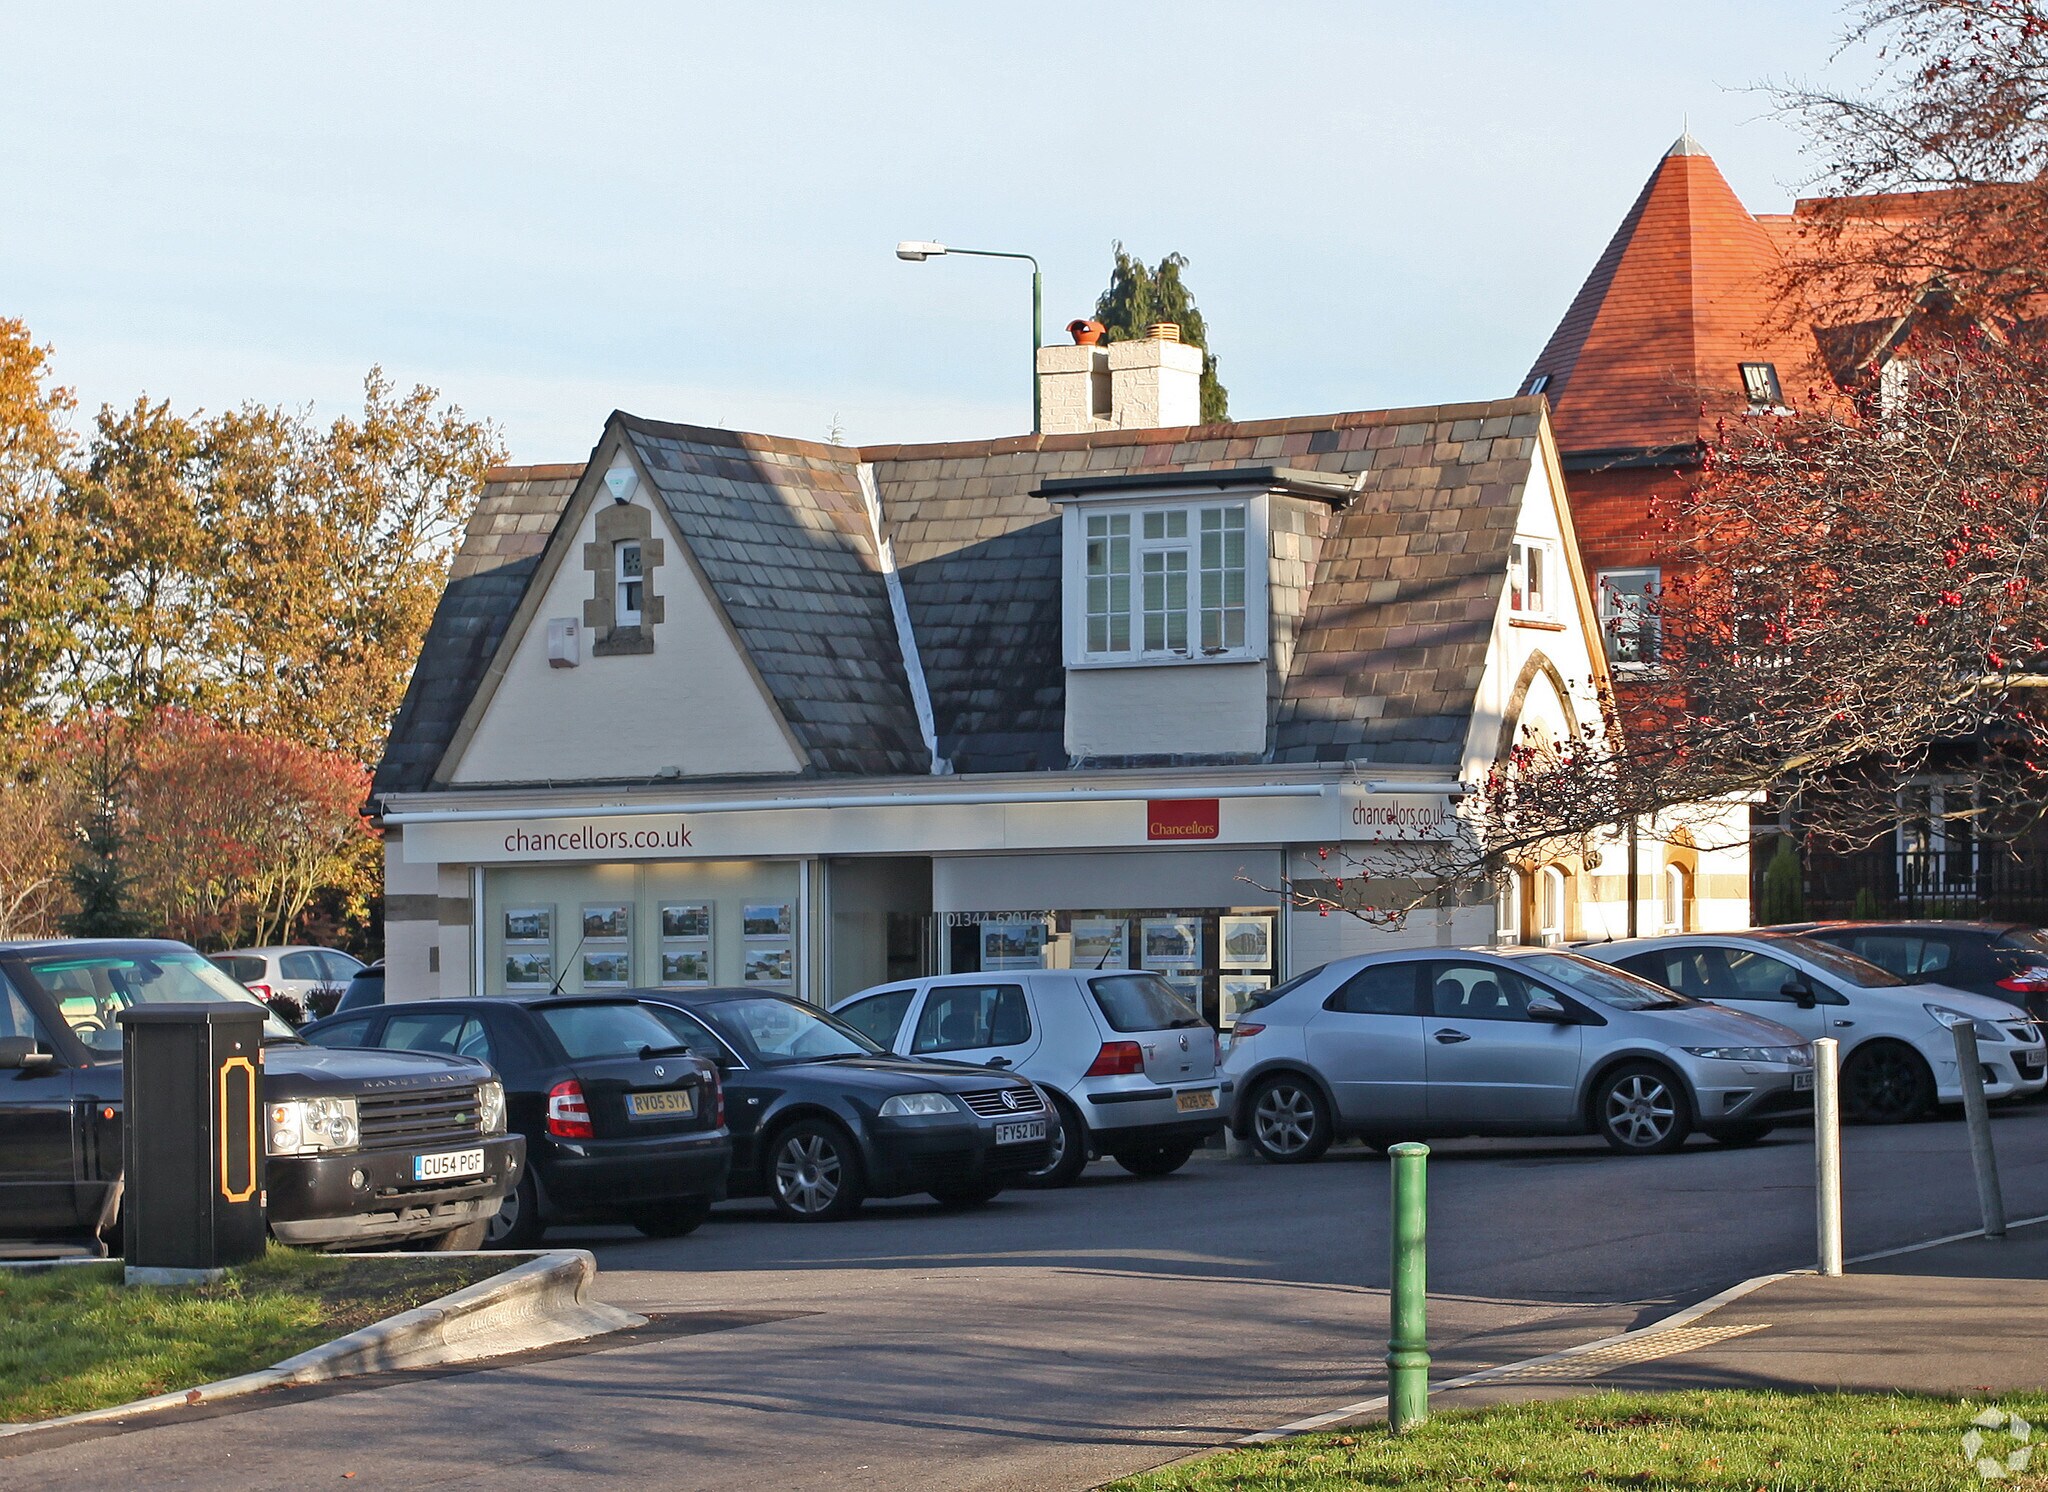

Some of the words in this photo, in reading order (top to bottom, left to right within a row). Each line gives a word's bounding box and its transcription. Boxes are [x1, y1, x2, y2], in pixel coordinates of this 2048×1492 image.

[1352, 800, 1446, 825] chancellors.co.uk
[504, 823, 692, 852] chancellors.co.uk
[1150, 821, 1215, 836] Chancellors
[946, 912, 990, 927] 01344
[634, 1095, 665, 1112] RV05
[666, 1094, 688, 1109] SYX
[1003, 1125, 1028, 1141] FY52
[424, 1156, 456, 1175] CU54
[460, 1153, 481, 1171] PGF
